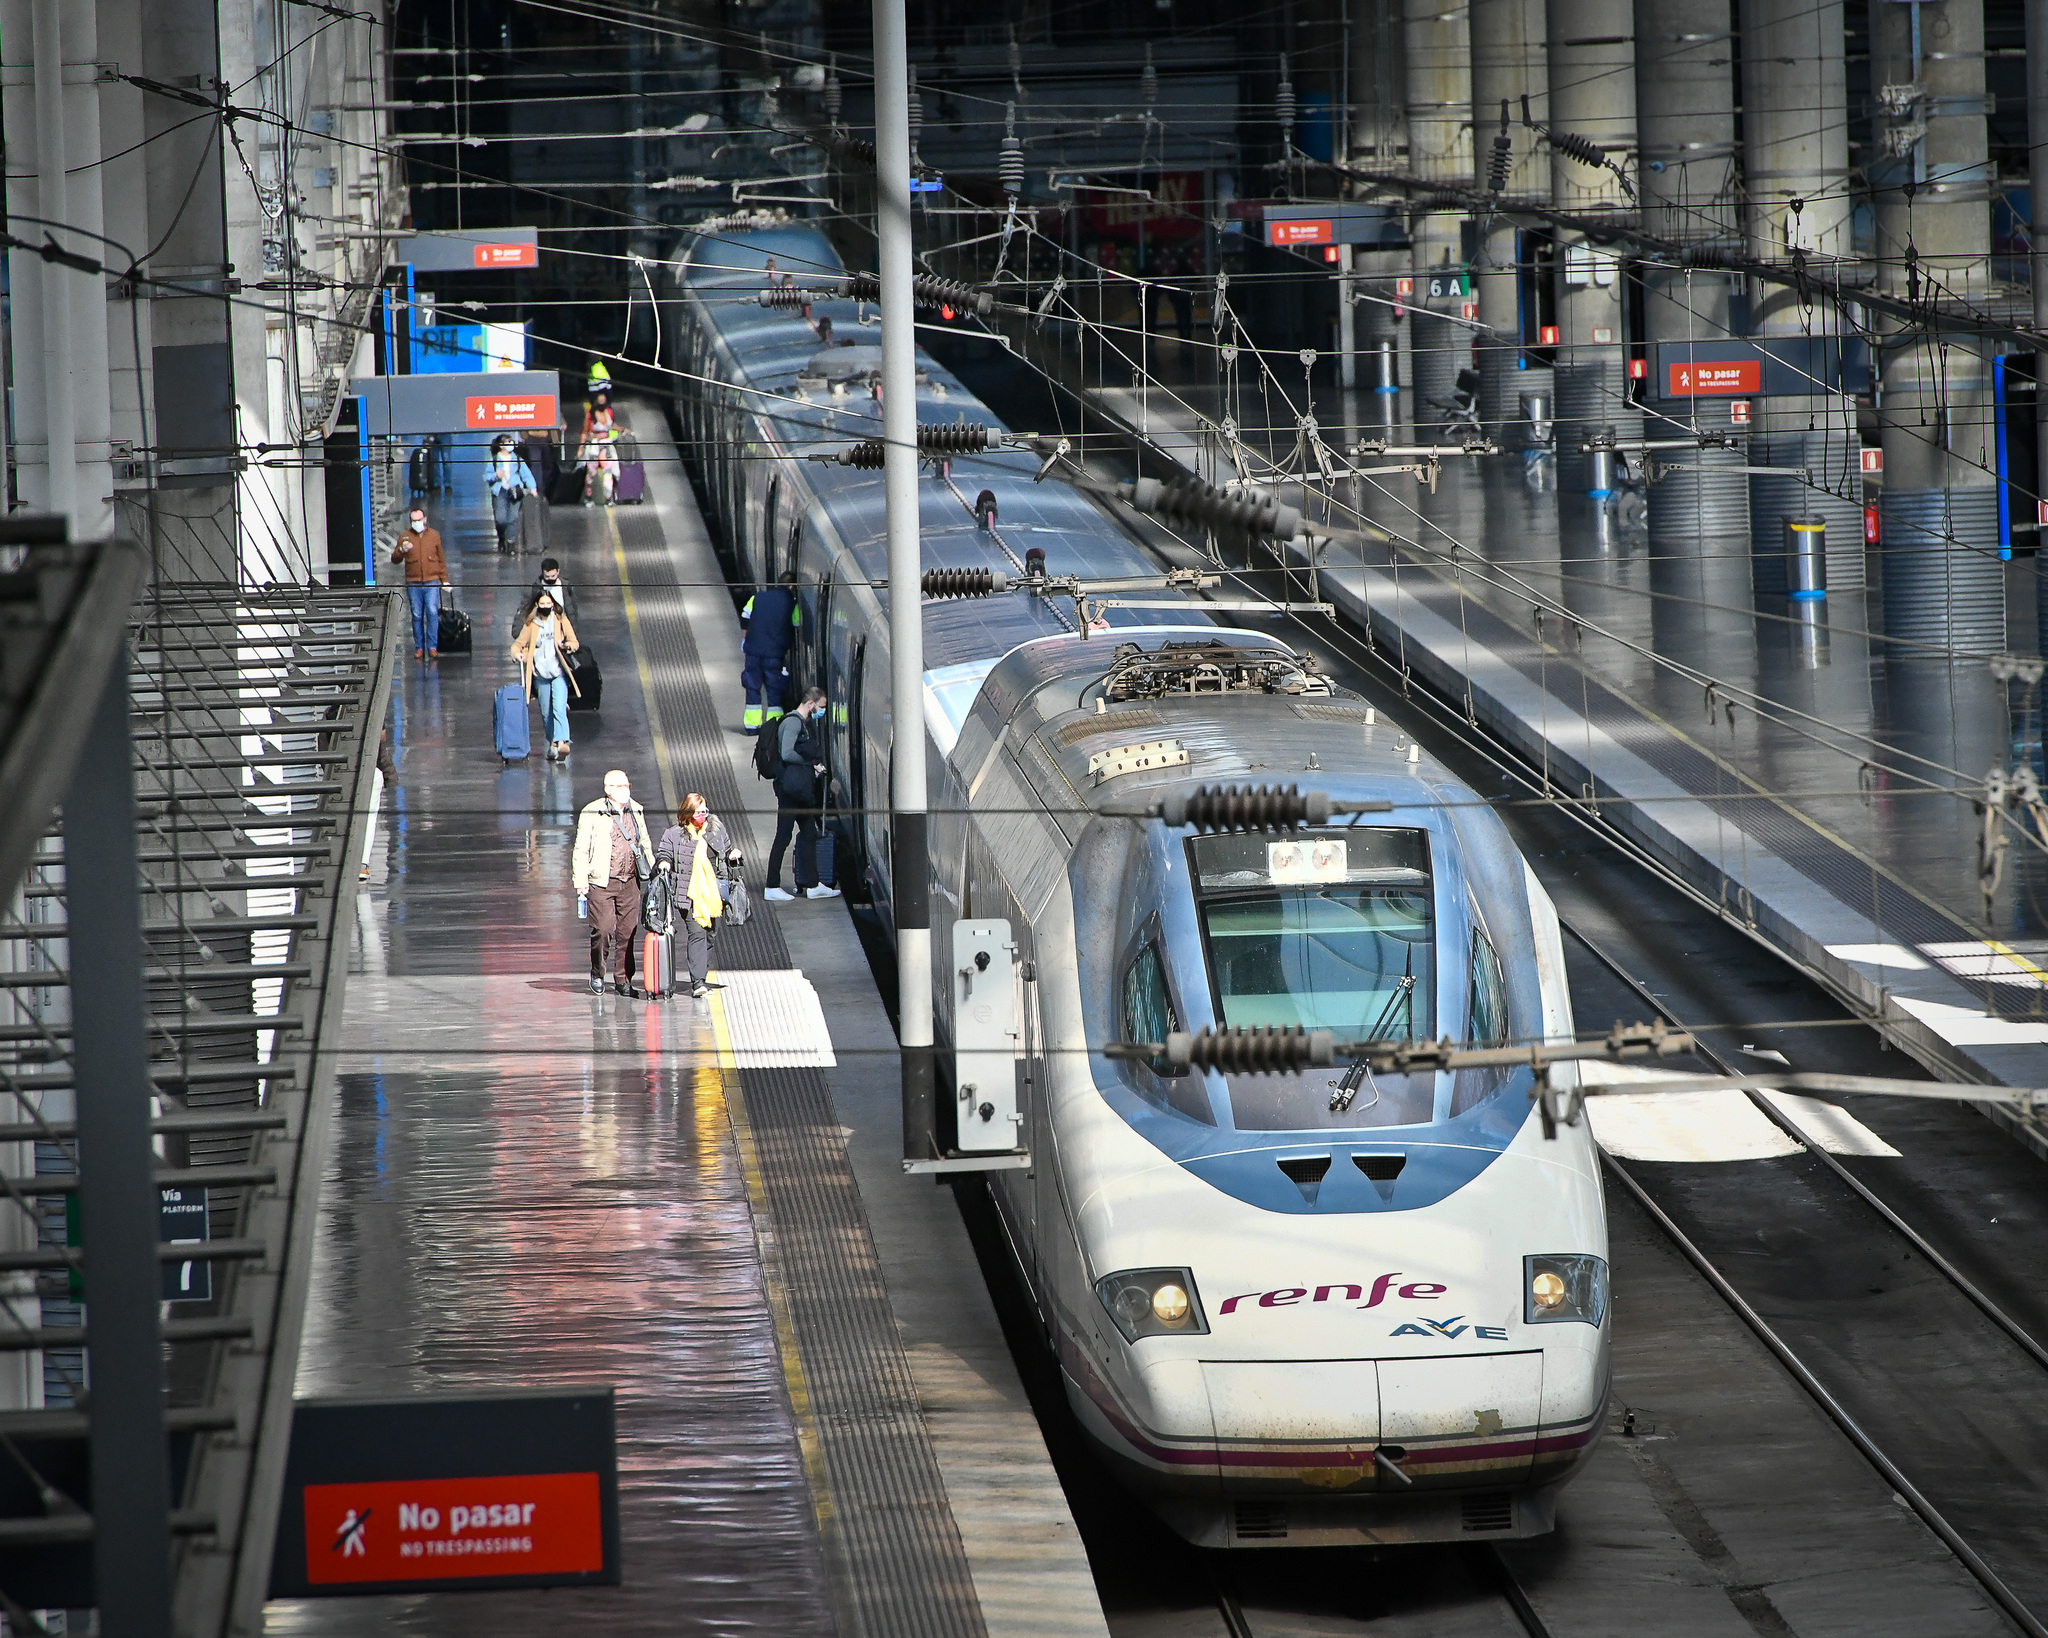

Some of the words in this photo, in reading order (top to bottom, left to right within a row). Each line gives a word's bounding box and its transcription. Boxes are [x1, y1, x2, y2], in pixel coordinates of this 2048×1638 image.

[1430, 279, 1442, 297] 6
[1449, 278, 1461, 297] A
[422, 307, 433, 326] 7
[1698, 369, 1712, 379] No
[1714, 369, 1741, 380] pasar
[494, 402, 507, 412] No
[509, 403, 536, 414] pasar
[161, 1188, 182, 1202] Vía
[162, 1204, 204, 1213] PLATFORM
[1219, 1272, 1448, 1315] renfe
[1388, 1317, 1509, 1341] AVE
[398, 1502, 440, 1532] No
[450, 1502, 536, 1536] pasar
[400, 1540, 424, 1557] NO
[426, 1535, 533, 1557] TRESPASSING
